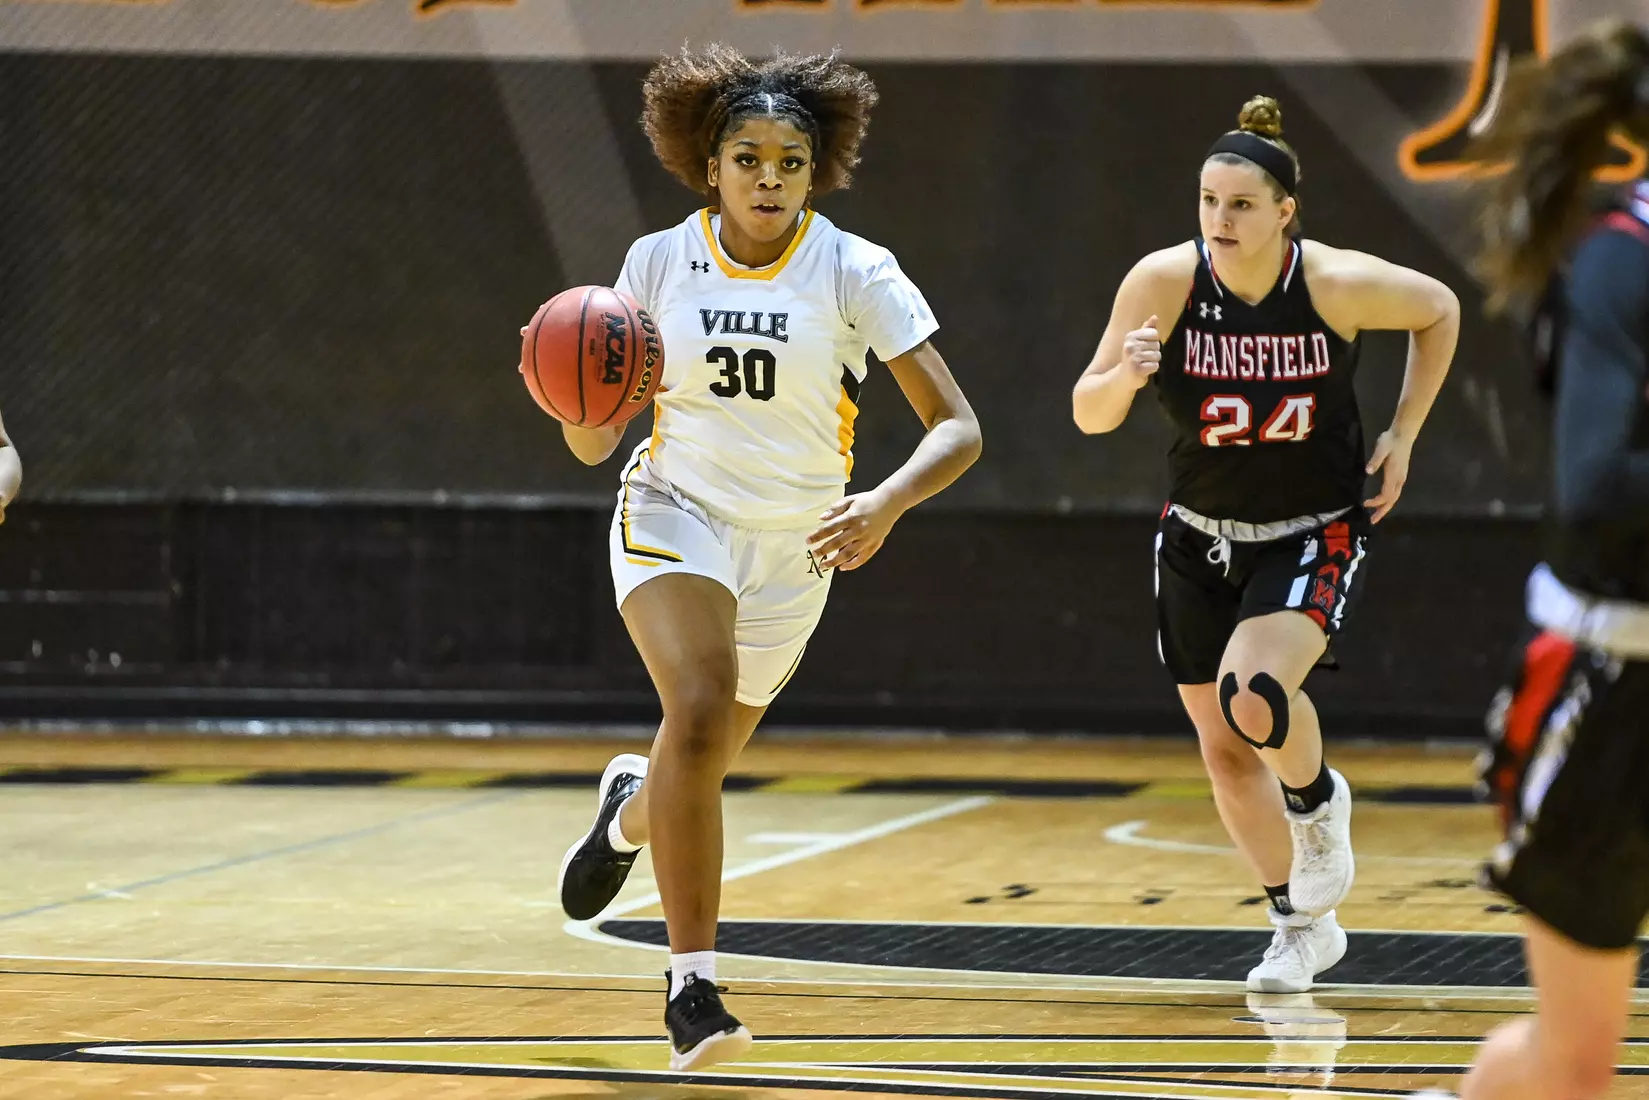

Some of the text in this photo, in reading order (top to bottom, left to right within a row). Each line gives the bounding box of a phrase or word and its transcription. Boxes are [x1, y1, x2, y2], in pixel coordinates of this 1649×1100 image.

[602, 311, 626, 385] NCAA
[699, 308, 789, 343] VILLE
[705, 346, 777, 402] 30
[1184, 328, 1331, 381] MANSFIELD
[1200, 393, 1317, 447] 24
